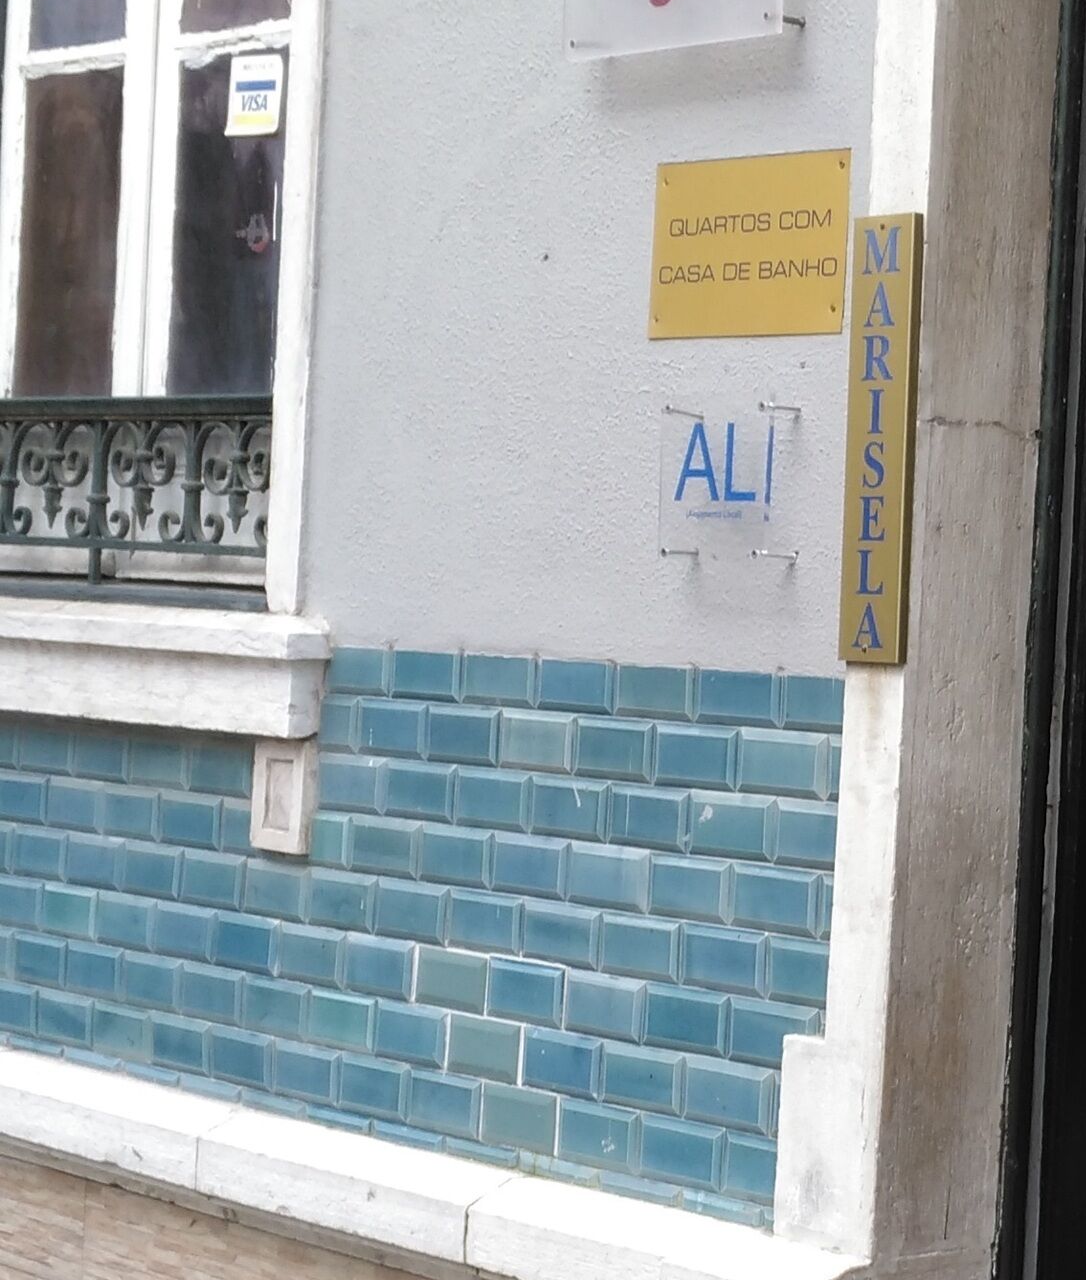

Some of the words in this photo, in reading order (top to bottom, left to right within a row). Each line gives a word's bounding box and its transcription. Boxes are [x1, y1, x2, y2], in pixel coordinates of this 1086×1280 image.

[241, 93, 268, 112] VISA
[669, 212, 771, 238] QUARTOS
[779, 208, 832, 231] COM
[659, 264, 715, 284] CASA
[723, 262, 750, 281] DE
[758, 257, 838, 280] BANHO
[852, 226, 900, 650] MARISELA
